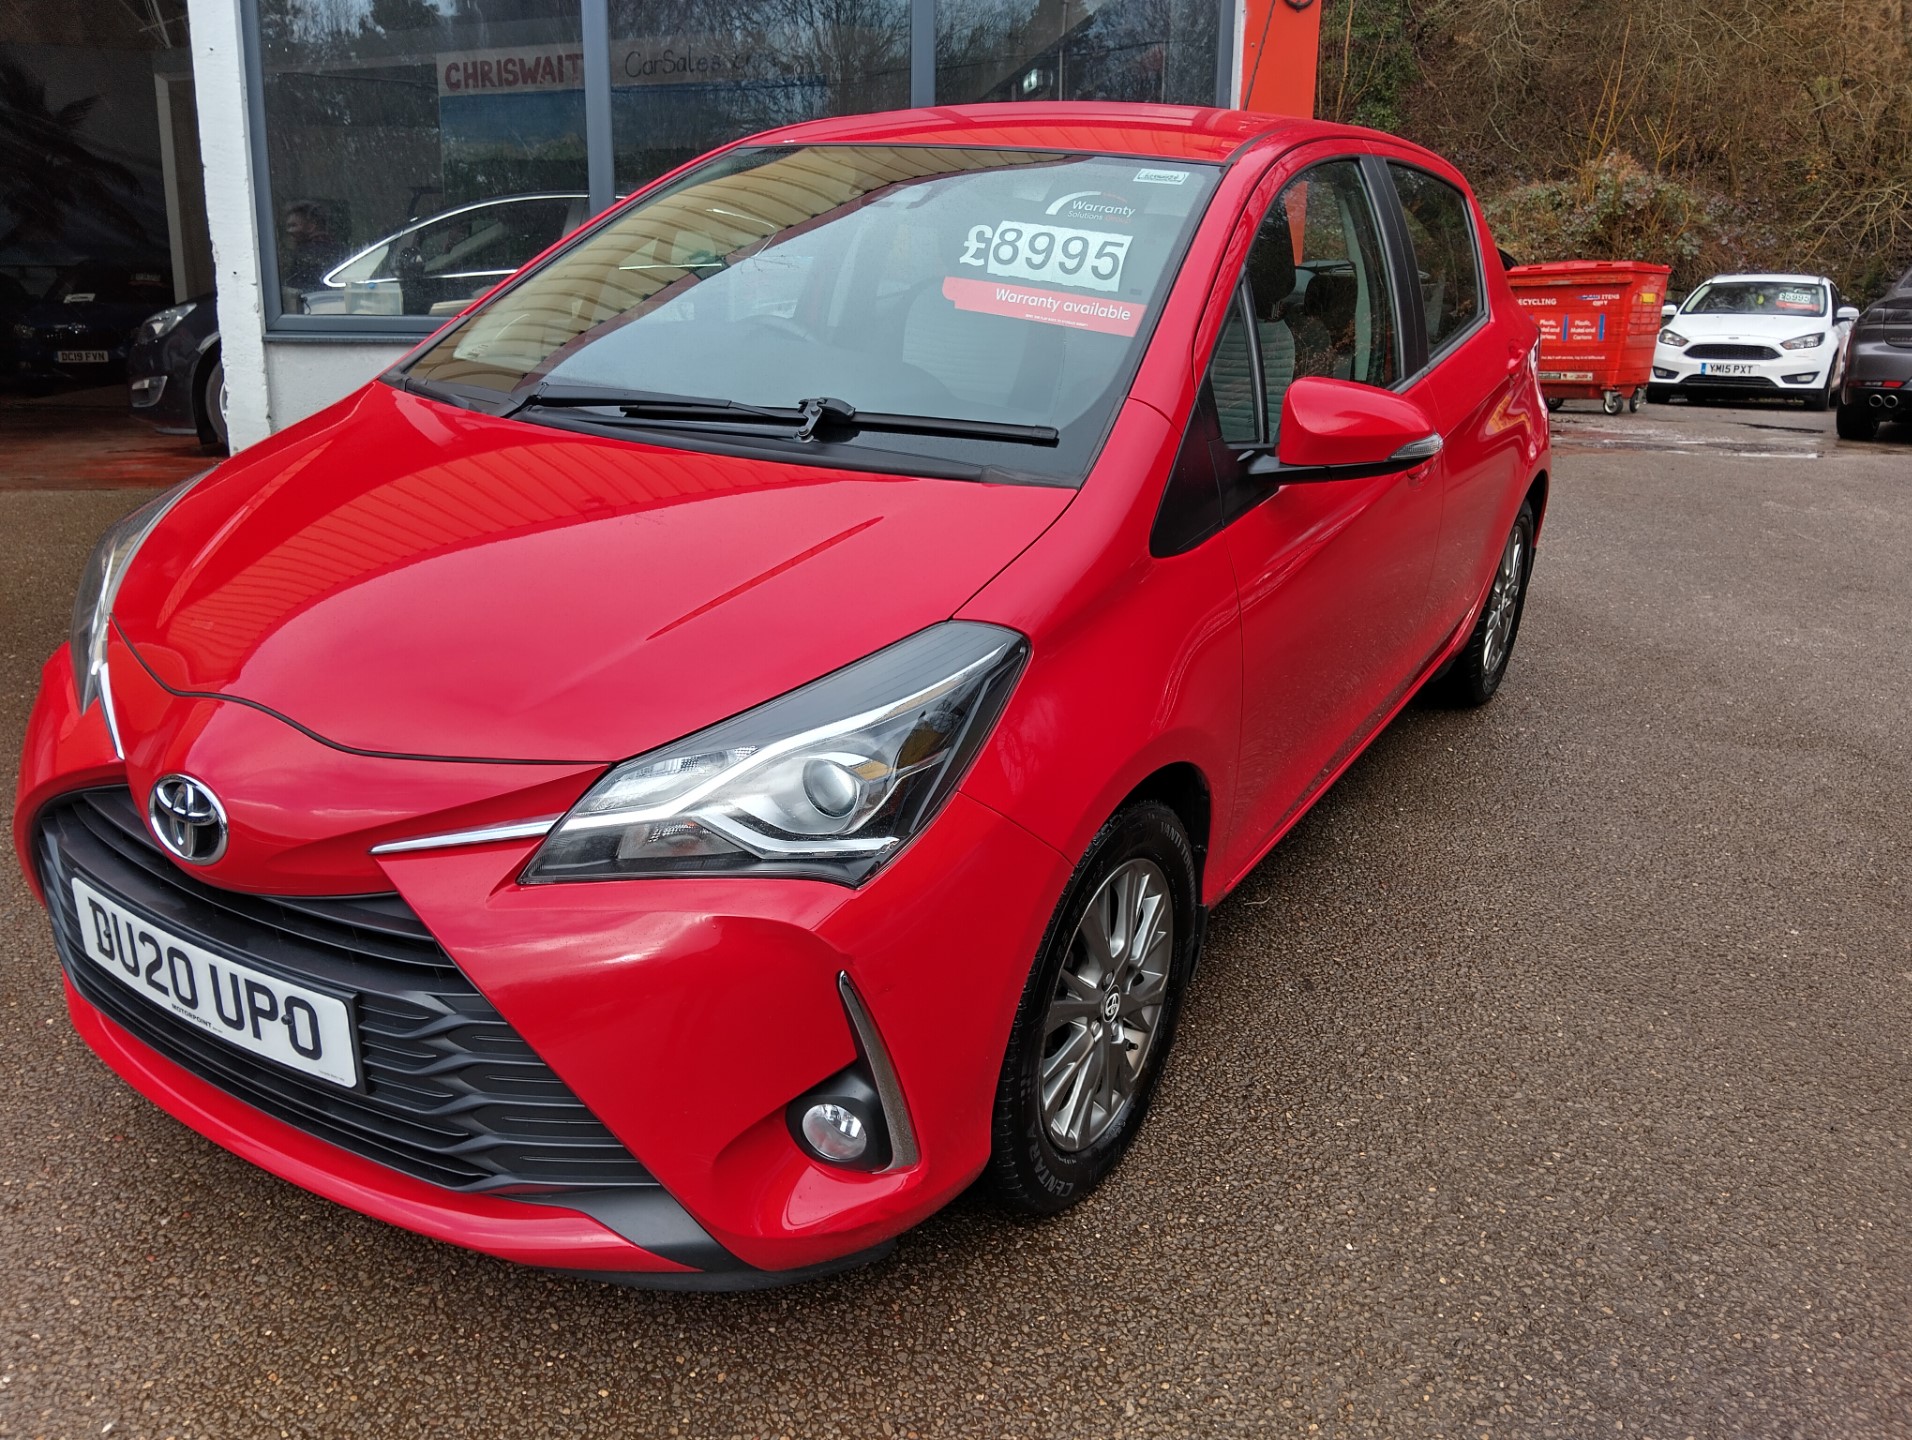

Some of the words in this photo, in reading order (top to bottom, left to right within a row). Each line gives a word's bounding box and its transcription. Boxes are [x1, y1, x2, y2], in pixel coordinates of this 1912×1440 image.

[1067, 211, 1103, 222] Solutions
[1072, 200, 1136, 218] Warranty
[959, 224, 1125, 281] £8995
[996, 287, 1060, 313] Warranty
[1063, 300, 1131, 320] available
[1517, 298, 1557, 306] ECYCLING
[1709, 364, 1731, 374] YM15
[1733, 364, 1753, 374] PXT
[208, 962, 323, 1061] UPO
